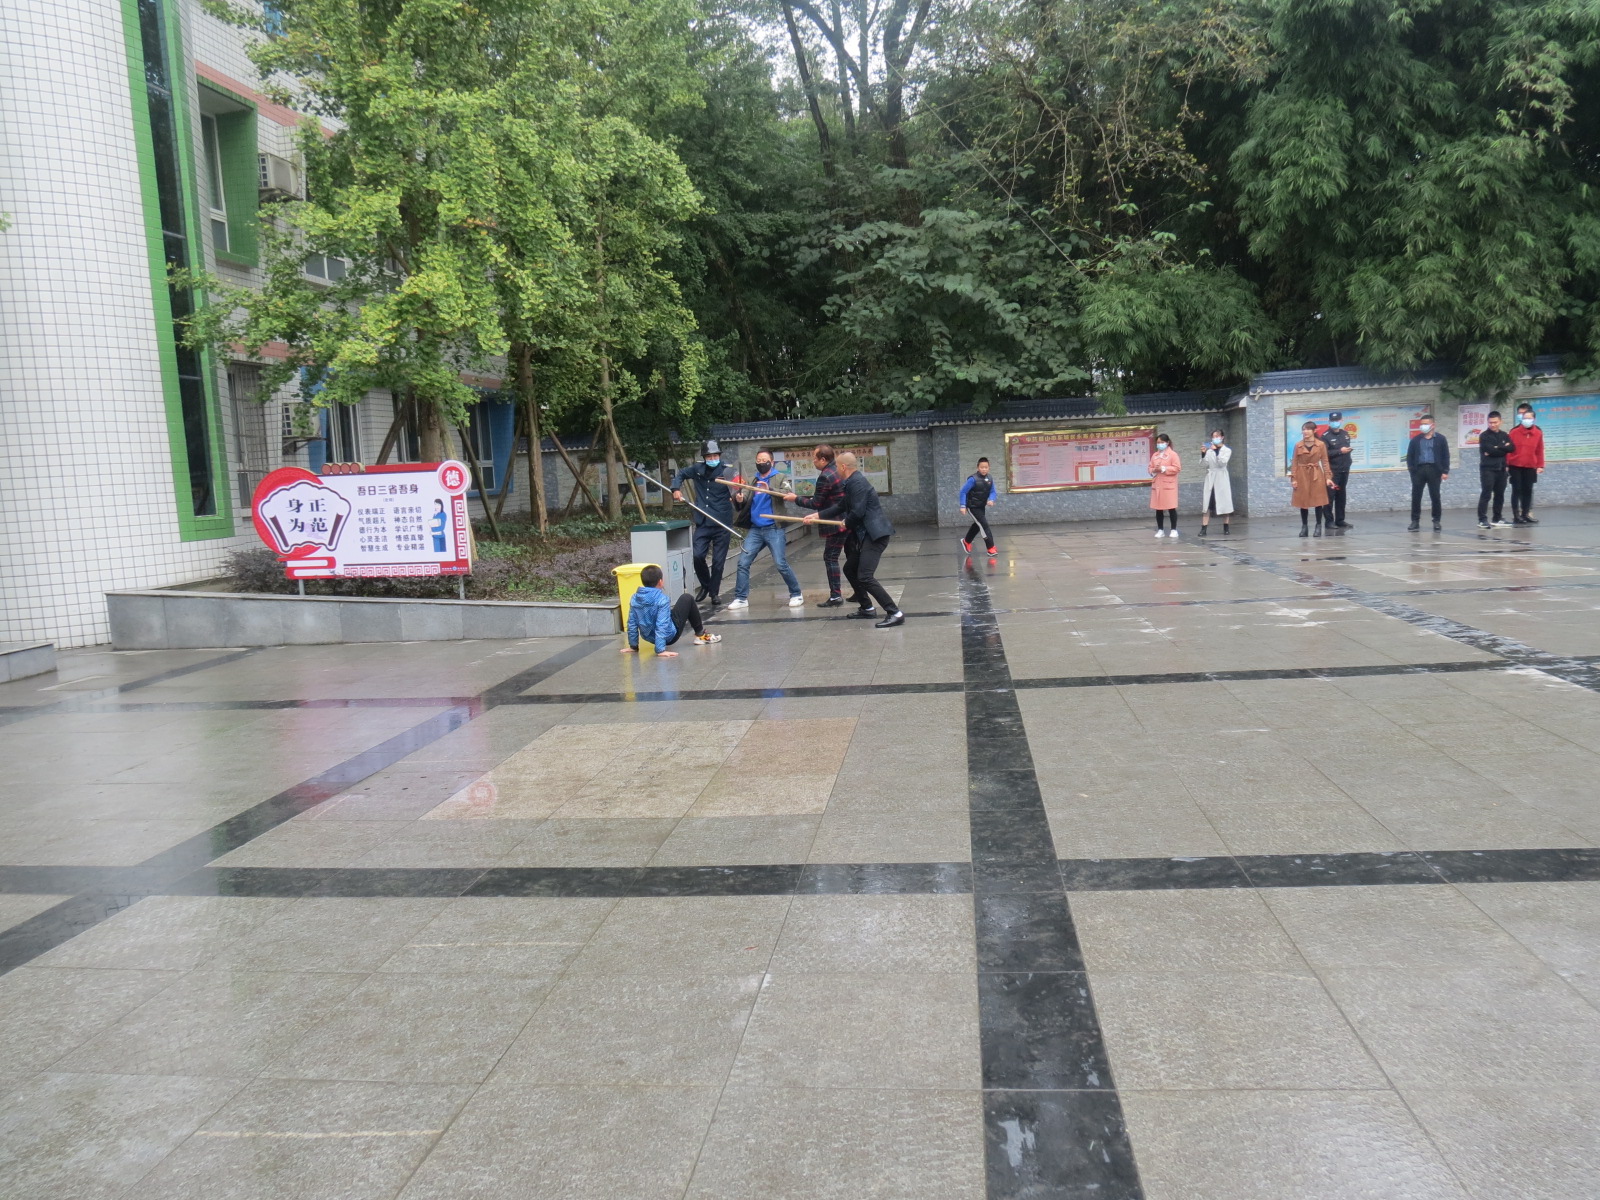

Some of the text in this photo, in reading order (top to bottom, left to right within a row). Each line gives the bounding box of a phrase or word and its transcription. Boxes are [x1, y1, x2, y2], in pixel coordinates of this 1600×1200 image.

[445, 470, 460, 487] 德
[357, 484, 419, 496] 吾日三省吾身
[357, 506, 422, 516] 仪表端正 语言亲切
[358, 515, 423, 525] 气质超凡 神态自然
[359, 524, 424, 534] 德行为本 学识广博
[360, 534, 425, 543] 心灵圣洁 情感真挚
[361, 543, 425, 552] 智慧生成 专业精湛
